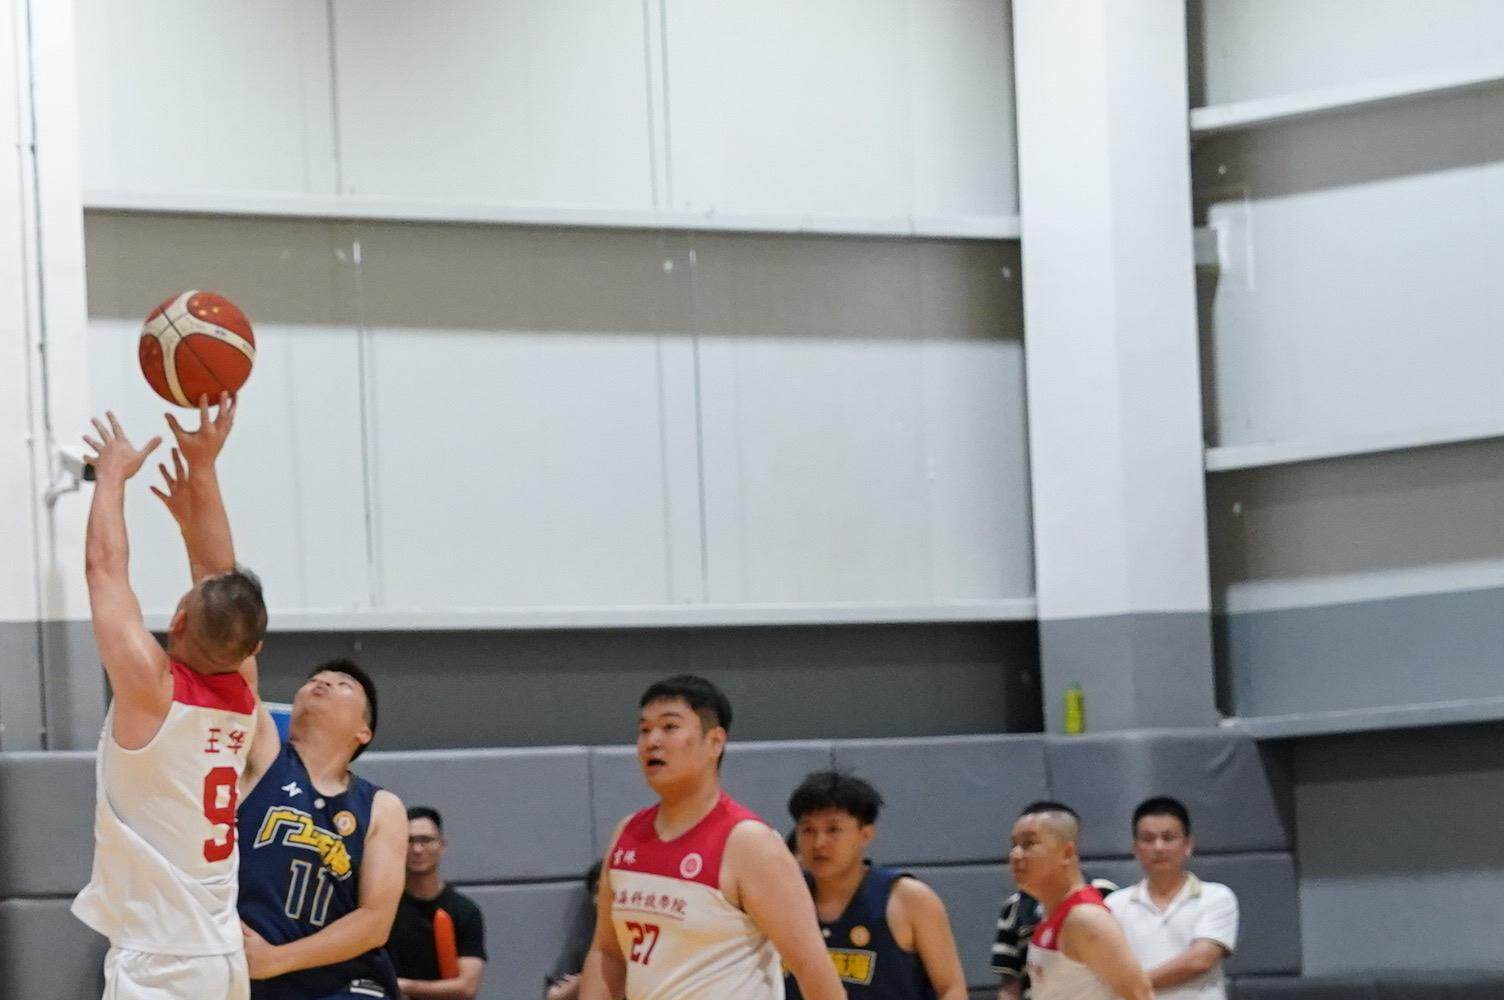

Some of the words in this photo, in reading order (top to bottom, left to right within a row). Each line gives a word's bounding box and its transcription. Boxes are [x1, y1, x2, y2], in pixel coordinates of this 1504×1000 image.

[203, 766, 239, 863] 9
[284, 858, 334, 927] 11
[625, 920, 661, 966] 27
